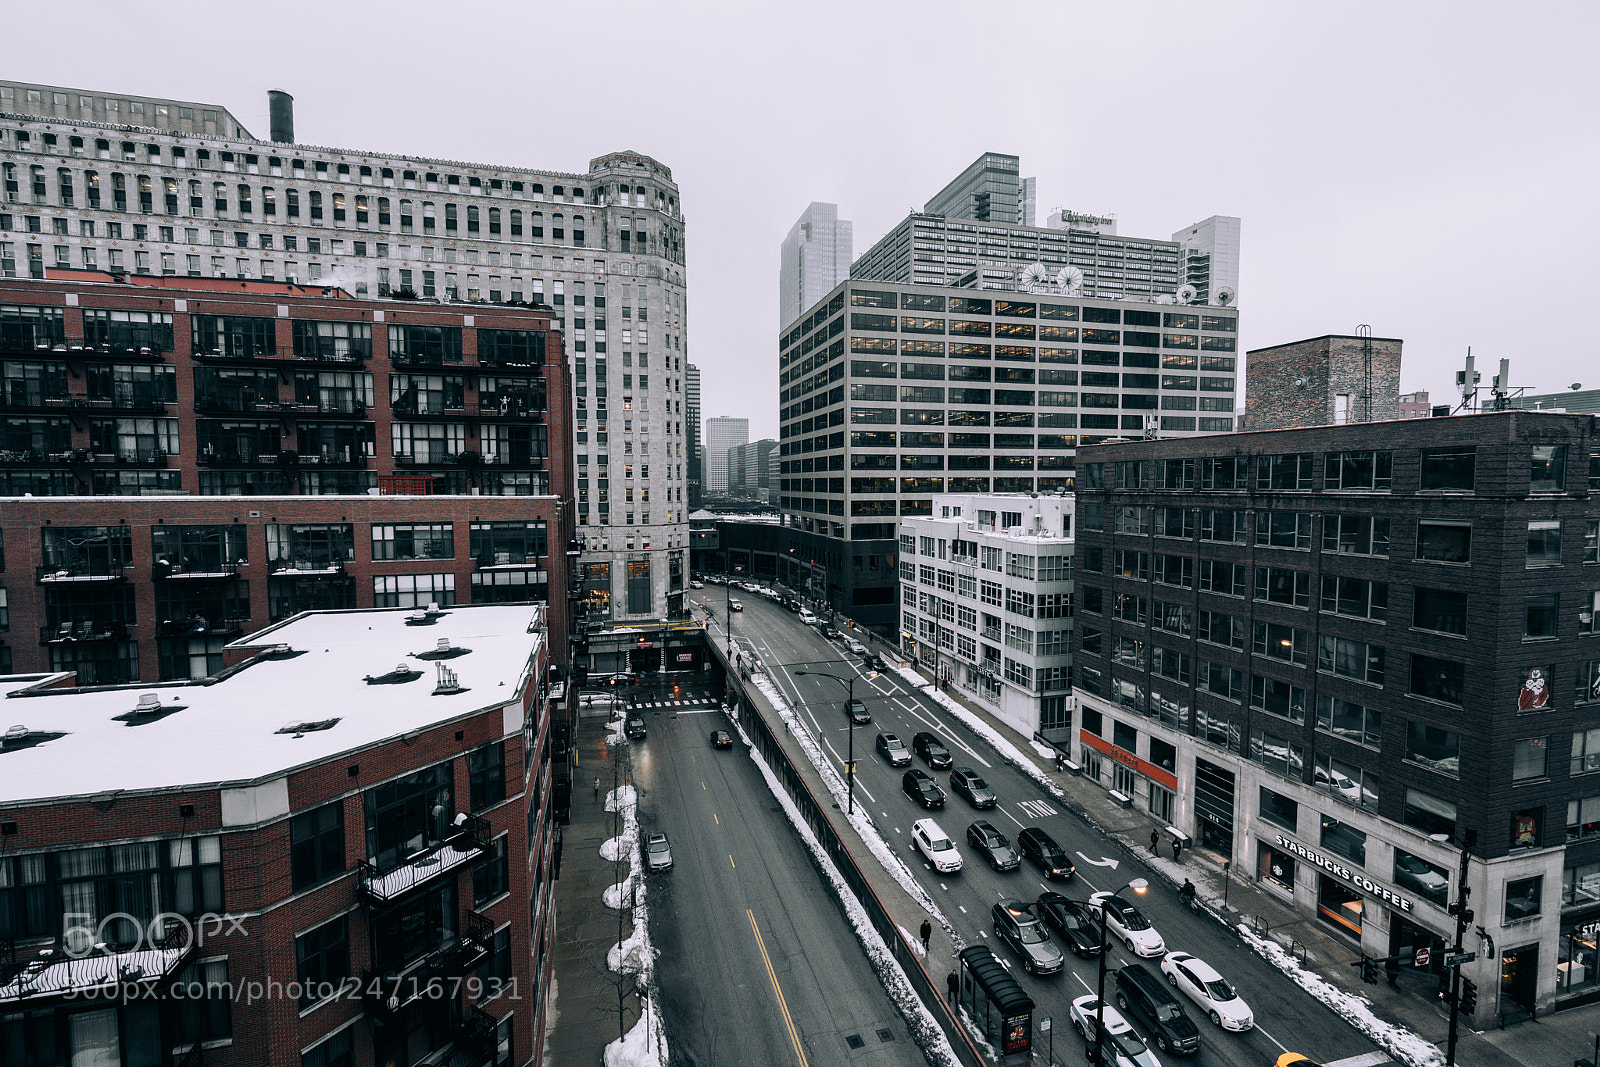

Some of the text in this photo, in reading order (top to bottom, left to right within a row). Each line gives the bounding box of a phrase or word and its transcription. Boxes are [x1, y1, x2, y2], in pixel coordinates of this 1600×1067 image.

[1016, 799, 1058, 819] ONLY
[1275, 834, 1410, 912] STARBUCKS COFFEE
